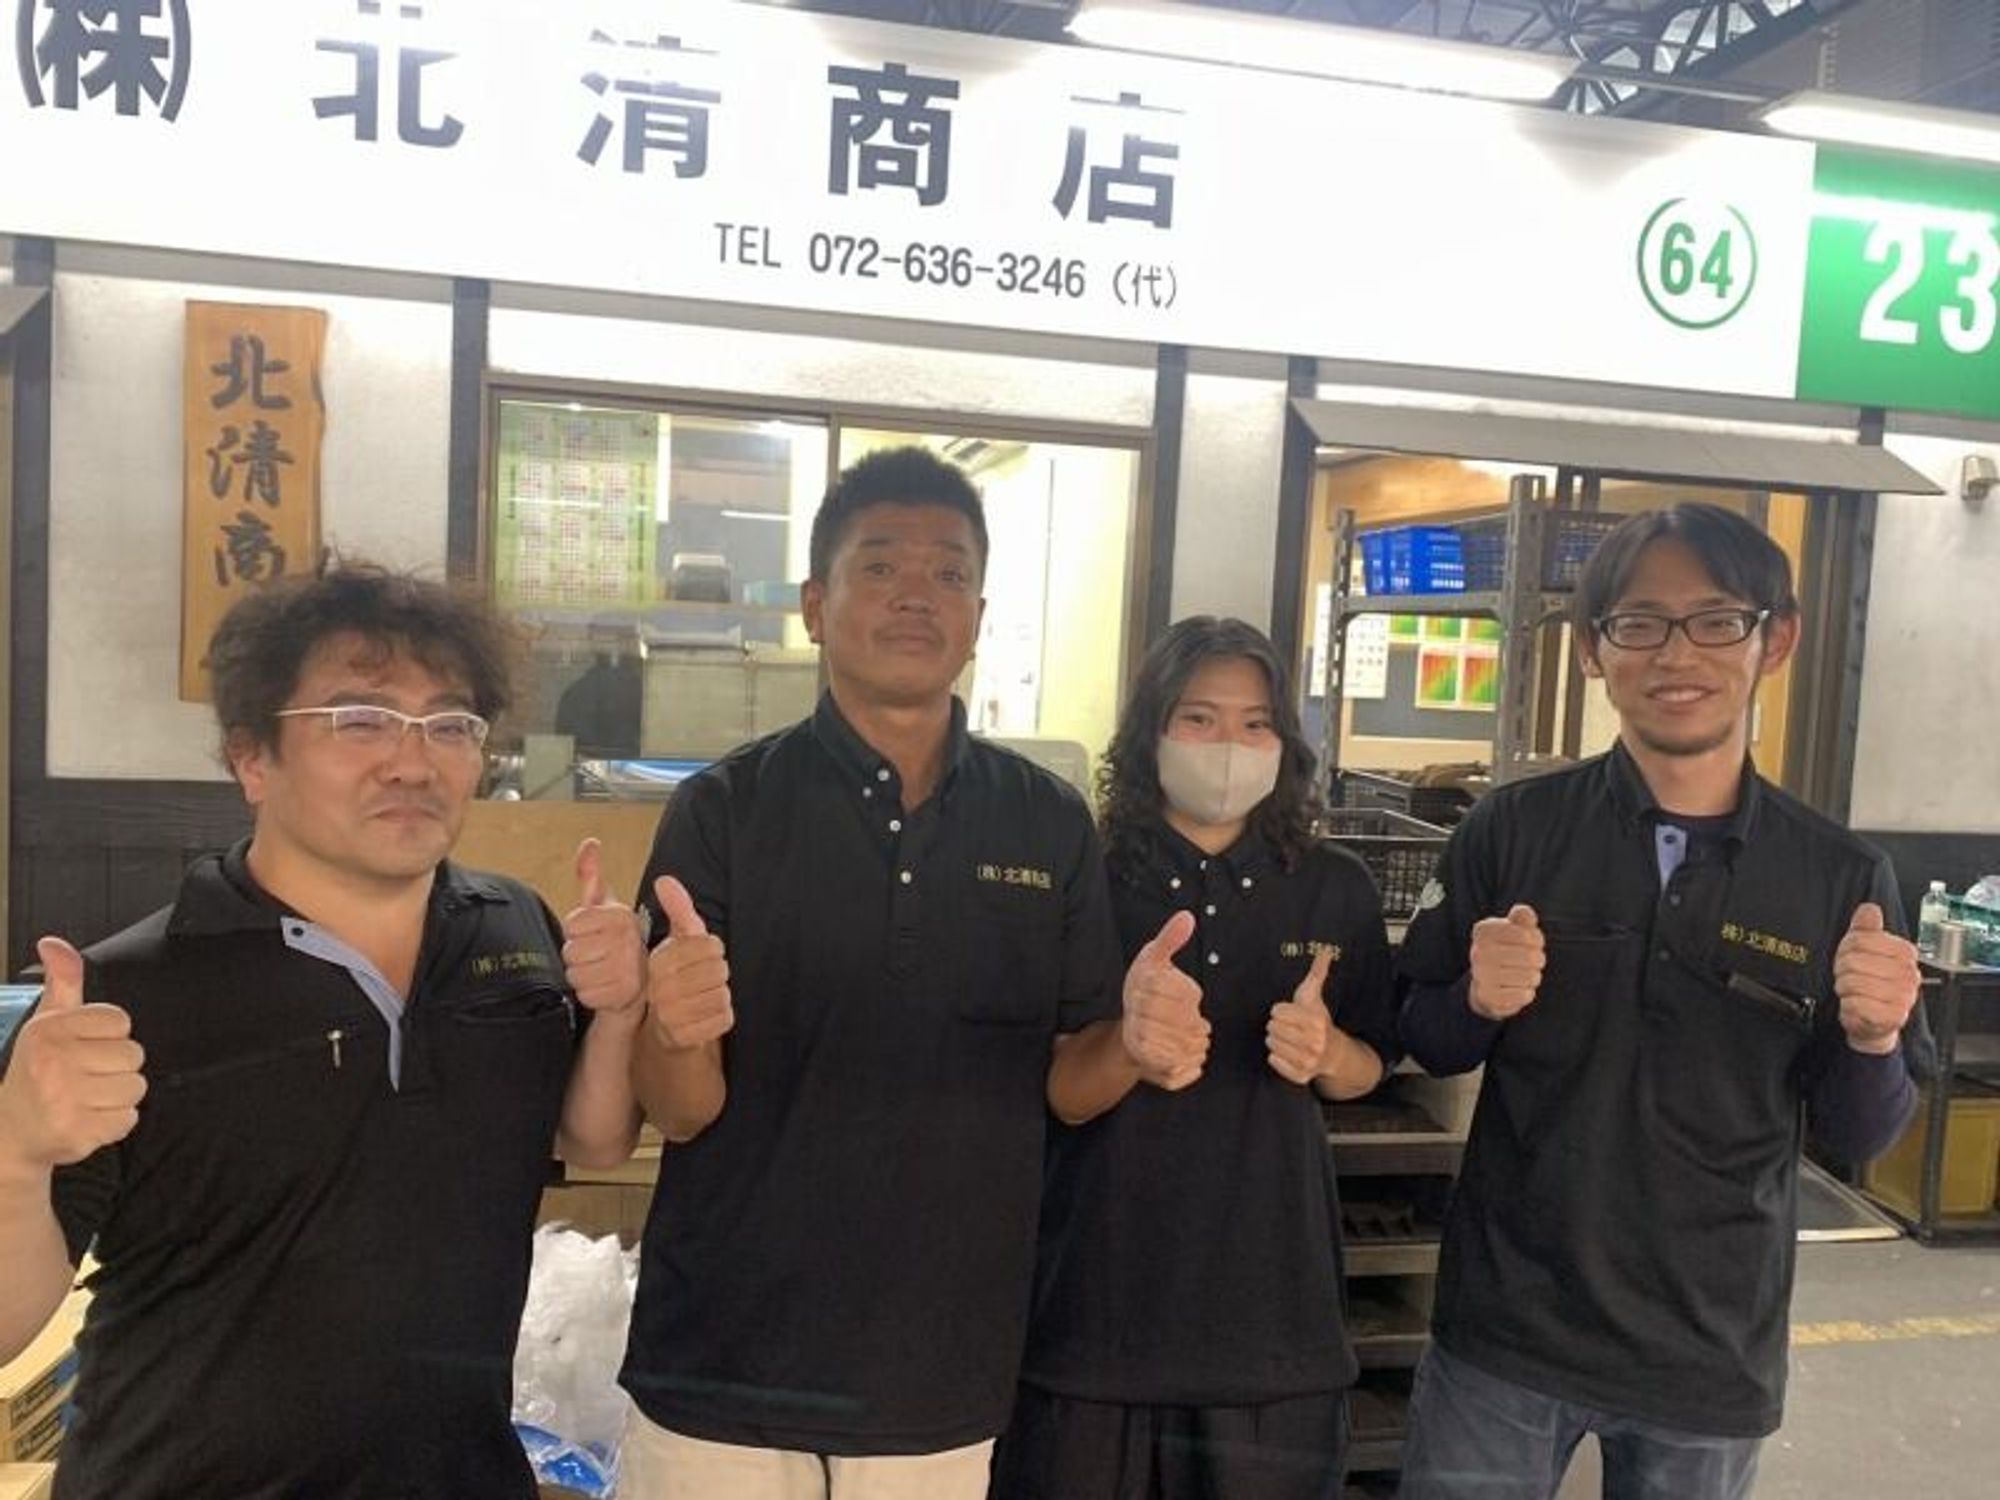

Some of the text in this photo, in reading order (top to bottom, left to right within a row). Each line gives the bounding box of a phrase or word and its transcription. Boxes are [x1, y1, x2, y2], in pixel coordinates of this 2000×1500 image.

[714, 222, 782, 269] TEL
[808, 232, 1086, 299] 072-636-3246
[1659, 221, 1734, 299] 64
[1859, 213, 1999, 354] 23
[205, 334, 294, 587] 北清商
